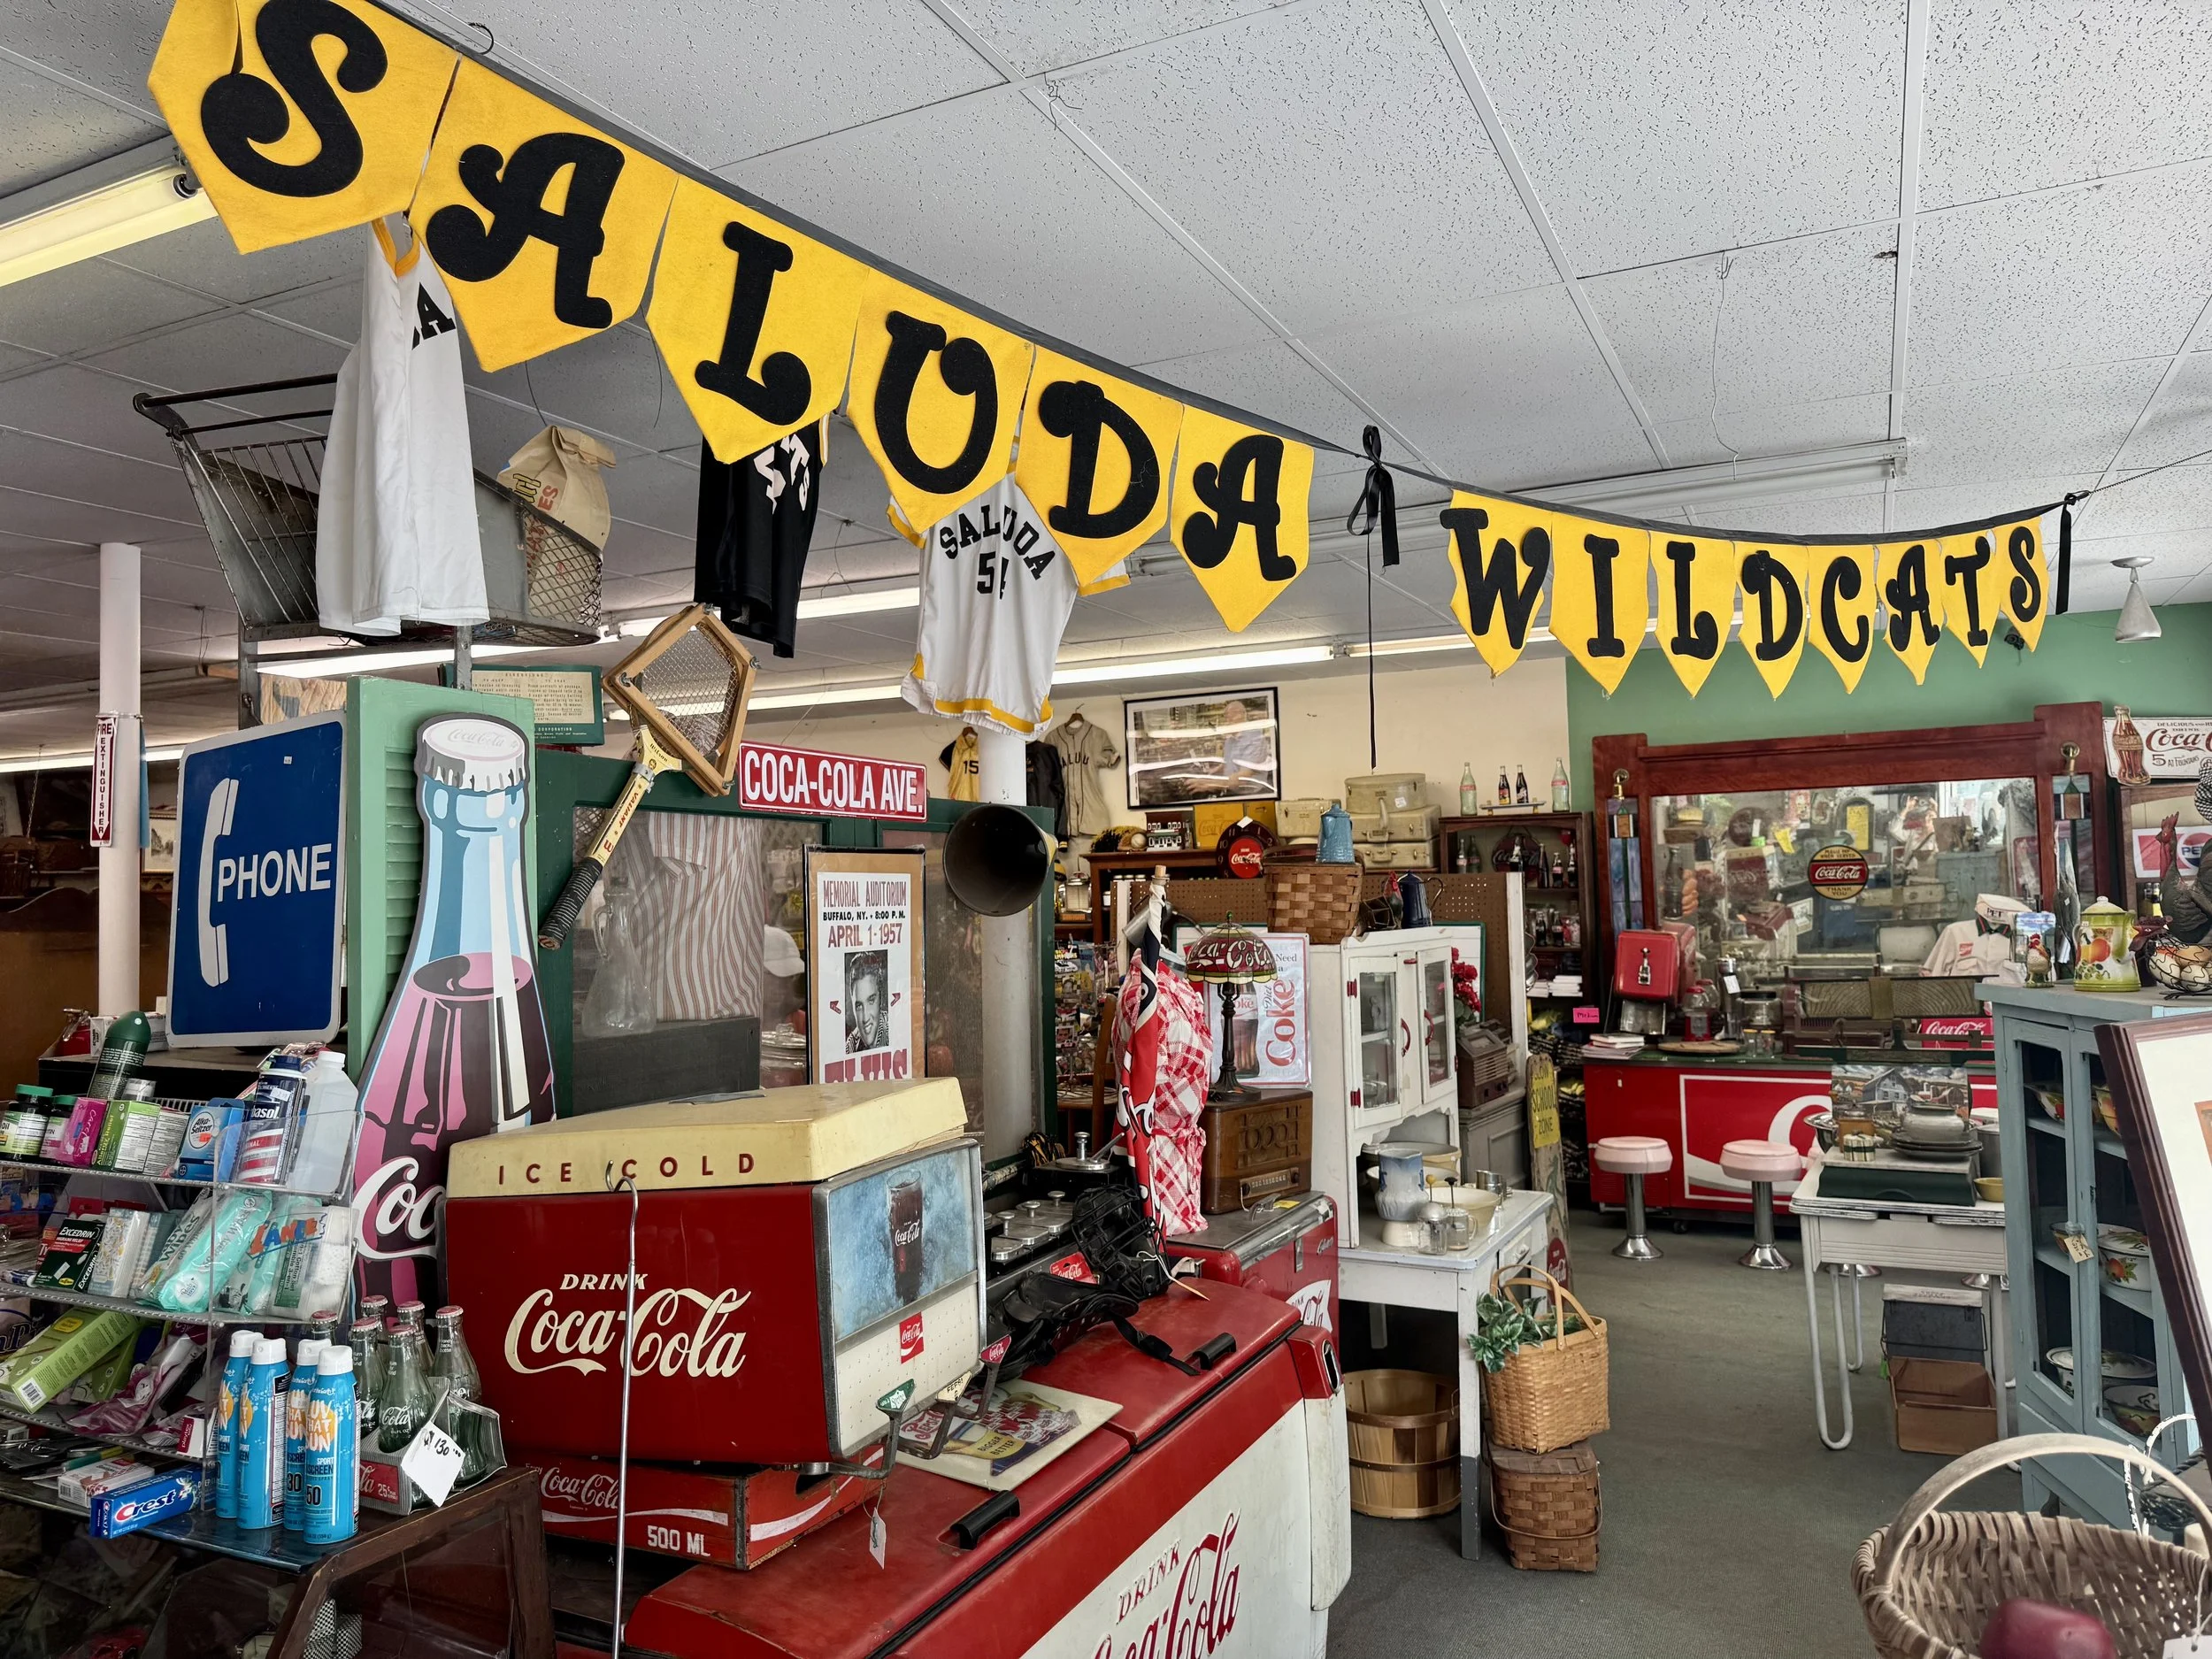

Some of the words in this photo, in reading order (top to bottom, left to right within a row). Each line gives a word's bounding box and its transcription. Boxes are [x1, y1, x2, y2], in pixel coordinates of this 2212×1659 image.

[1440, 508, 2036, 663] WILDCATS
[963, 760, 979, 774] 15
[744, 749, 877, 810] COCA-COLA
[879, 767, 924, 813] AVE.
[618, 791, 639, 828] VALIANT
[1231, 853, 1262, 864] Coca-Cola
[217, 842, 333, 902] PHONE
[1815, 865, 1863, 880] Coca-Cola
[823, 879, 861, 909] MEMORIAL
[865, 880, 907, 908] AUDITORIUM
[823, 911, 855, 922] BUFFALO,
[856, 910, 868, 920] NY.
[874, 910, 889, 919] 8:00
[827, 924, 864, 949] APRIL
[1234, 1000, 1255, 1009] oke
[1263, 985, 1273, 1010] Diet
[1265, 979, 1298, 1067] Coke
[1532, 1085, 1556, 1113] SCHOOL
[190, 1124, 212, 1135] Seltzer
[195, 1118, 211, 1127] Alka-
[1539, 1117, 1554, 1135] ZONE
[498, 1162, 572, 1186] ICE
[621, 1152, 755, 1180] COLD
[58, 1226, 96, 1239] EXCEDRIN
[895, 1219, 921, 1247] Coca-Cola
[77, 1255, 97, 1290] EXCEDRIN
[560, 1273, 649, 1291] DRINK
[503, 1287, 752, 1377] Coca-Cola
[902, 1322, 921, 1343] Coca-Cola
[977, 1436, 1002, 1452] BIGGER
[990, 1440, 1016, 1456] BETTER
[317, 1456, 334, 1466] SPORT
[287, 1472, 303, 1494] 30
[115, 1488, 177, 1524] Crest
[306, 1486, 322, 1506] 50
[647, 1525, 680, 1551] 500
[686, 1531, 711, 1557] ML
[1115, 1539, 1181, 1626] DRINK
